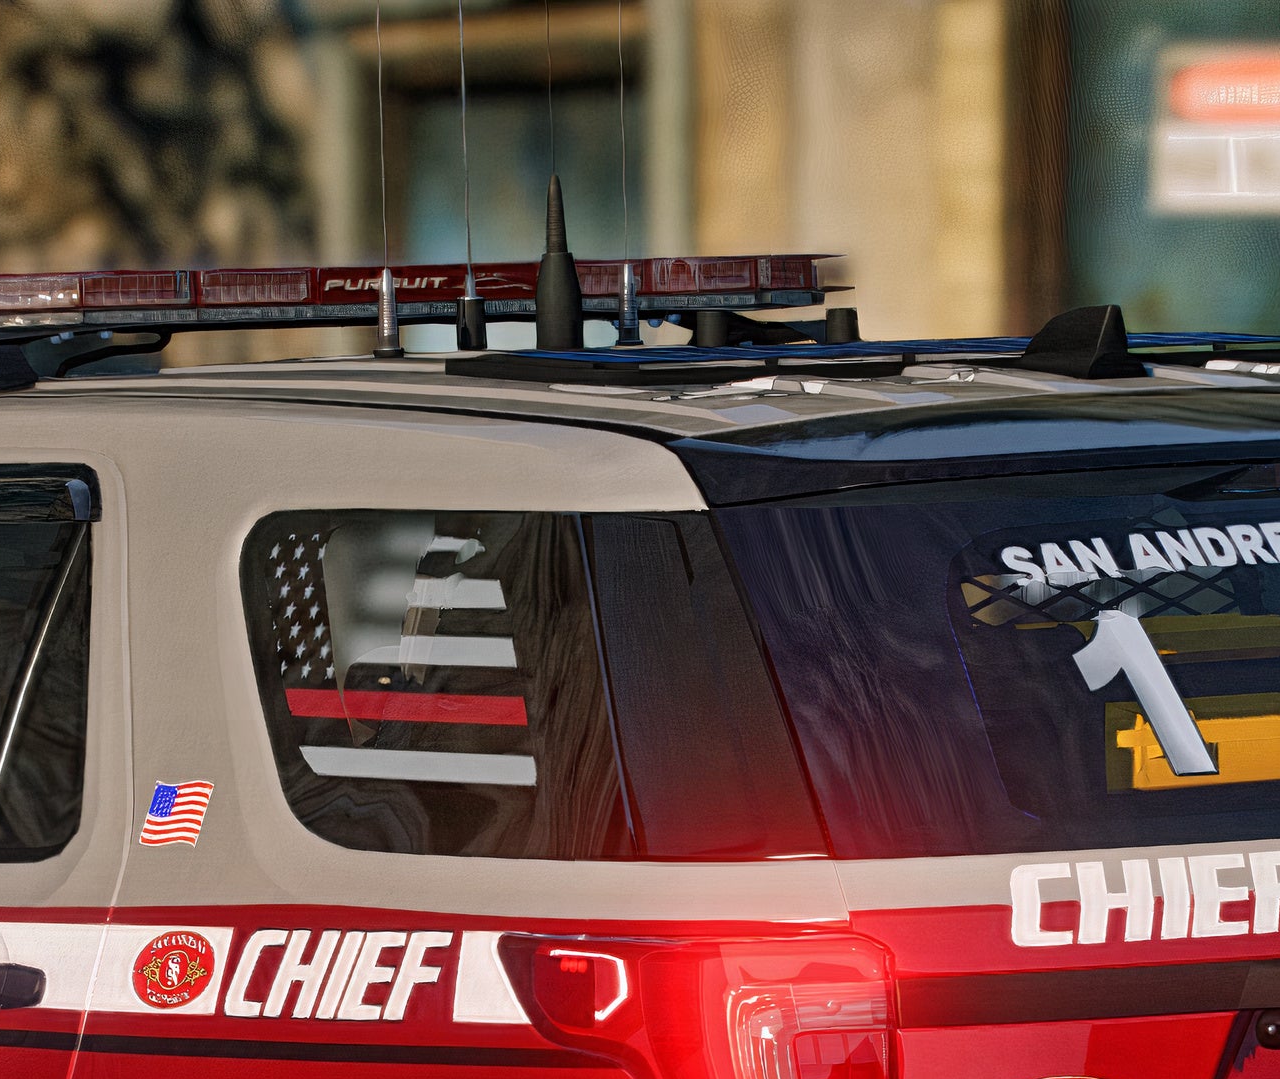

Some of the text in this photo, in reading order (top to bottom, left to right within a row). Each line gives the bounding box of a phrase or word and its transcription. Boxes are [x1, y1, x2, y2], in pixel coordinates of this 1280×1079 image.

[1000, 537, 1123, 587] SAN
[1071, 609, 1218, 776] 1
[224, 928, 454, 1022] CHIEF
